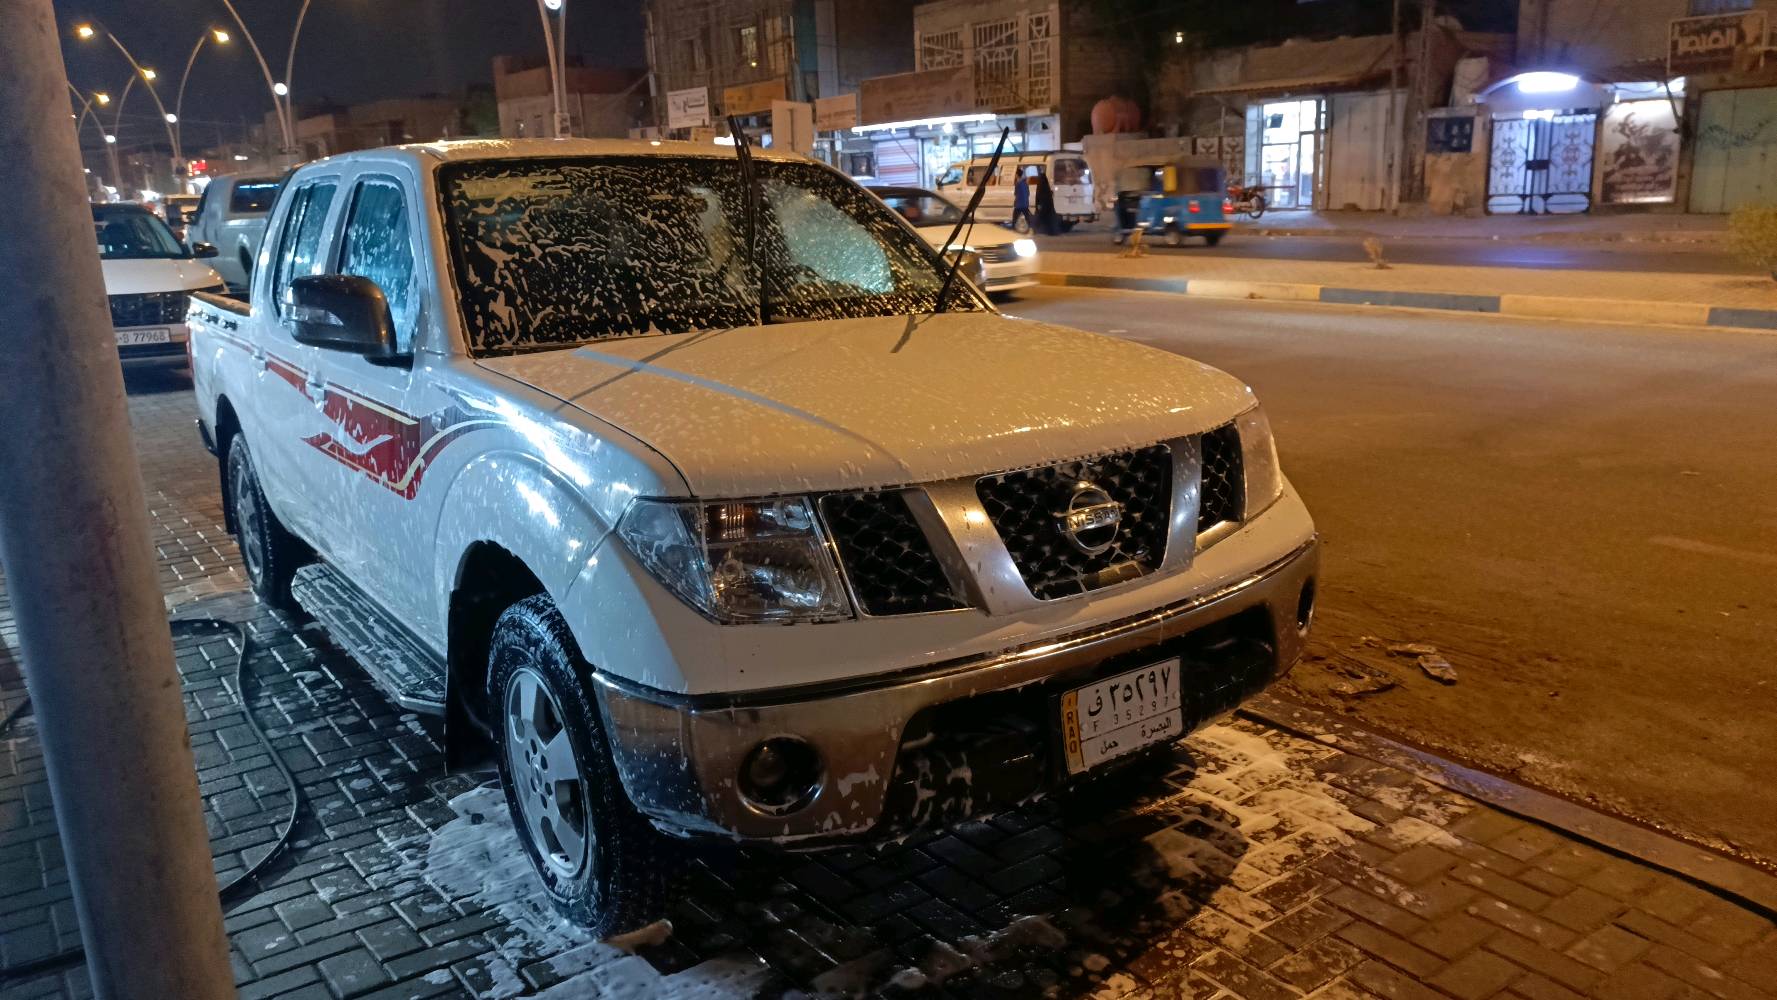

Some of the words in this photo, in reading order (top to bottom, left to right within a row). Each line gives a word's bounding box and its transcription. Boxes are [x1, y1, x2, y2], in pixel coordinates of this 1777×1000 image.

[1069, 508, 1118, 528] NISSAN
[1109, 666, 1171, 710] ٣٥٢٩٧
[1066, 697, 1077, 754] IRAQ
[1141, 717, 1172, 738] البصرة
[1100, 740, 1119, 754] حمل
